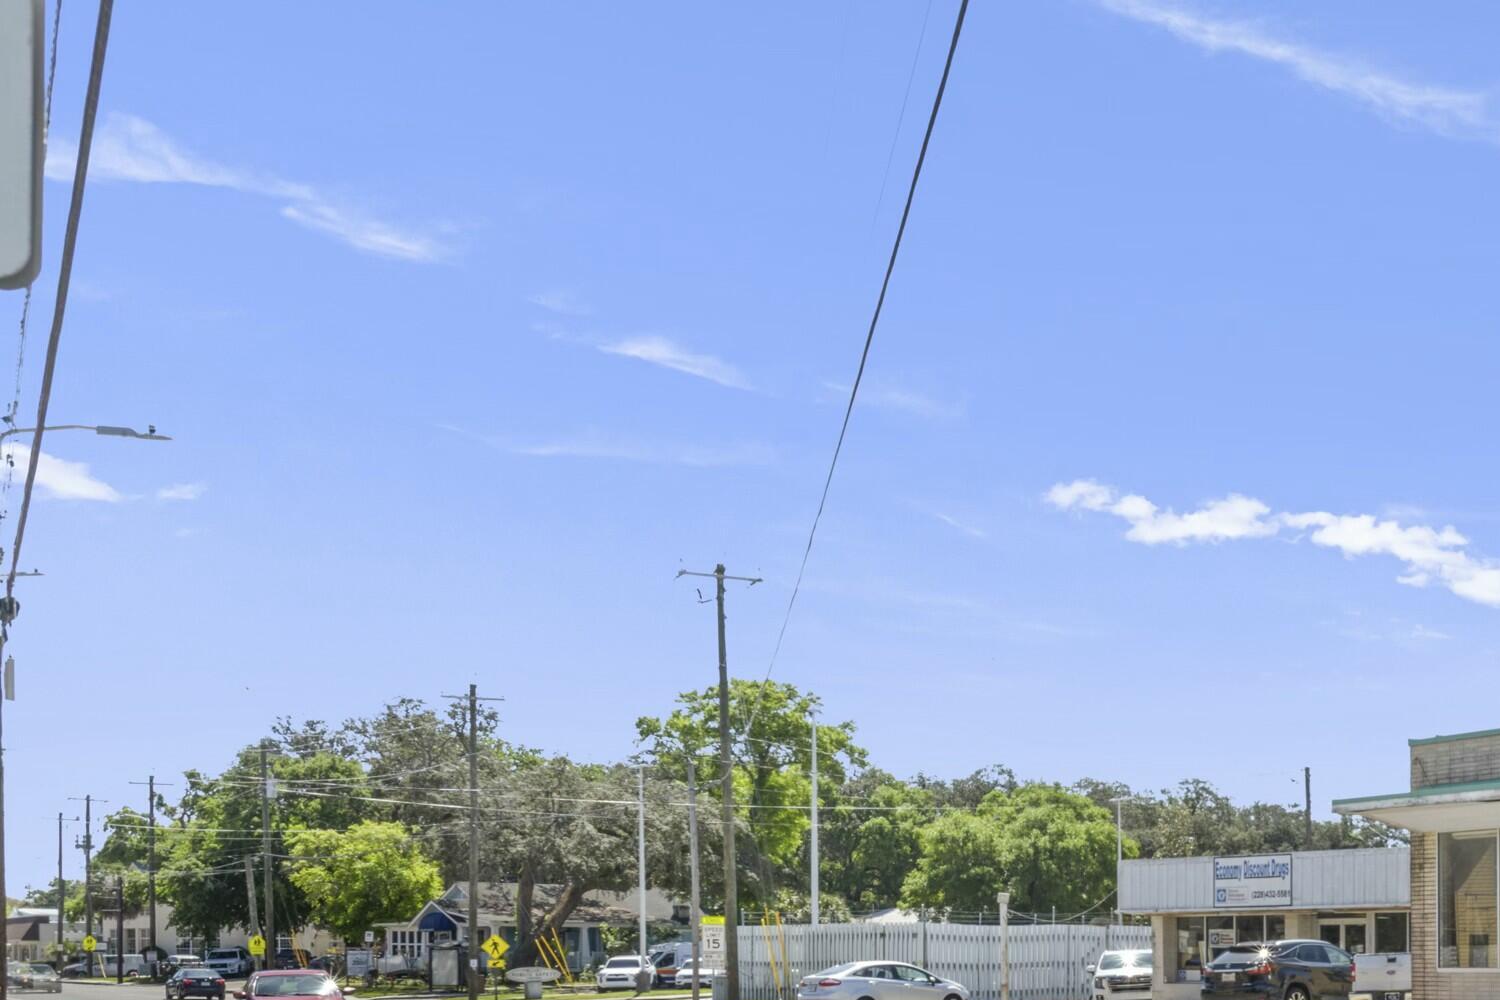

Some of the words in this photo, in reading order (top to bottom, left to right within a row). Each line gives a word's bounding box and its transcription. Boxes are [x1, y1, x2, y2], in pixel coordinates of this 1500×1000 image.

[1215, 862, 1242, 881] Economy
[1243, 860, 1271, 879] Discount
[1271, 859, 1289, 880] Drugs
[706, 938, 721, 949] 15
